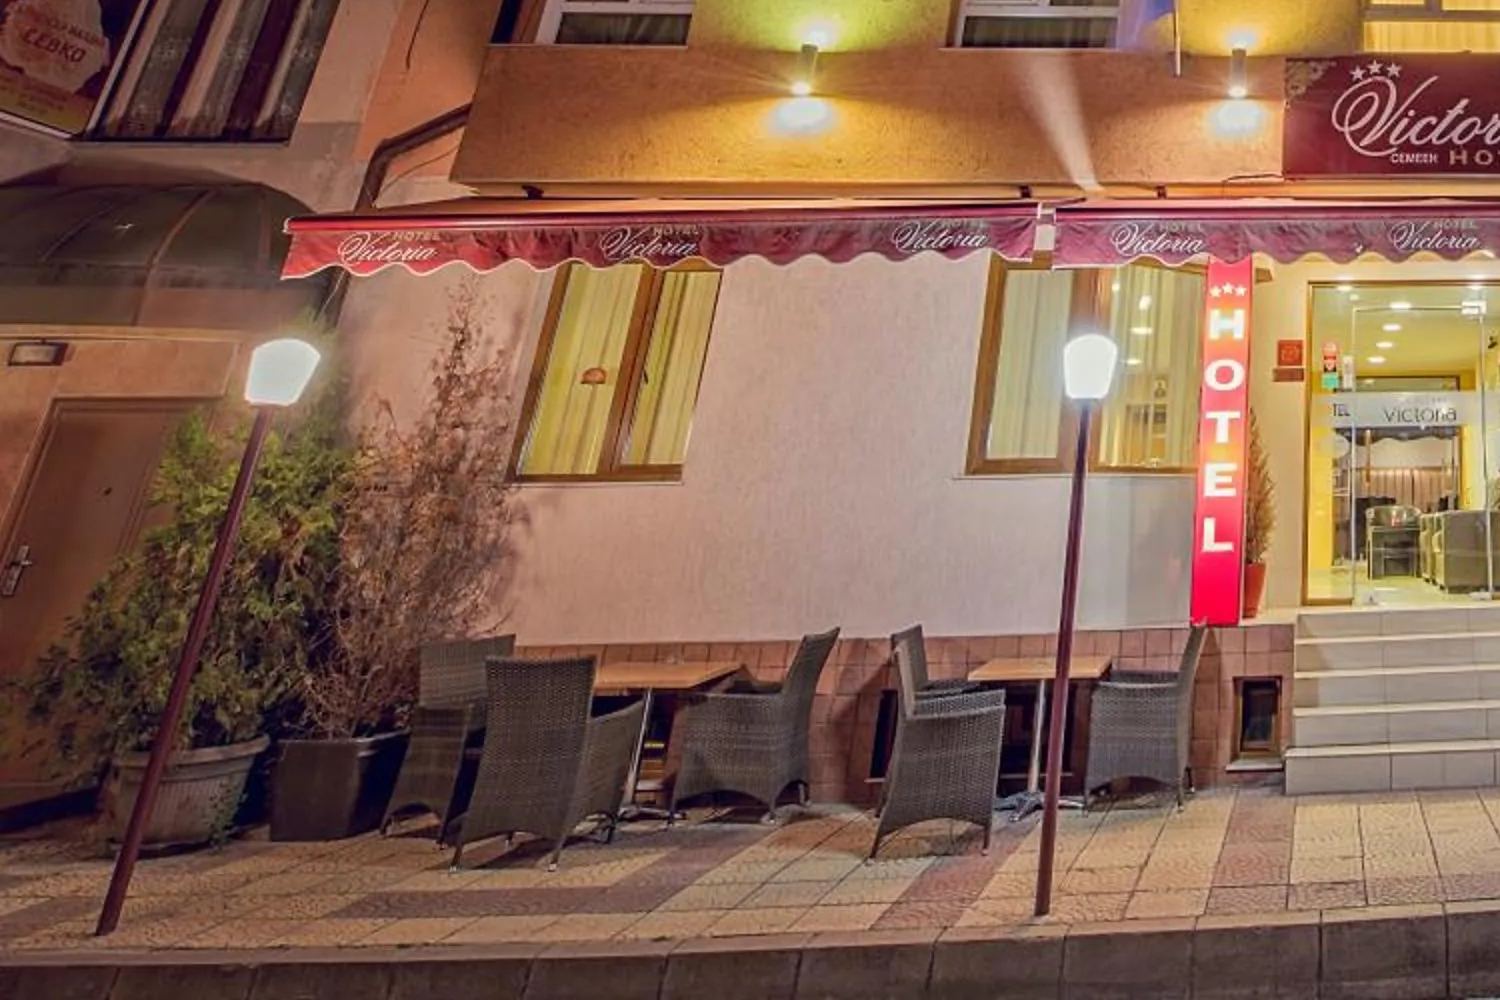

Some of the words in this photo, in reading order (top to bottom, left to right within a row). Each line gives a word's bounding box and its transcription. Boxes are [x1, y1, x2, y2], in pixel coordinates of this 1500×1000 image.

[337, 231, 437, 266] Victoria
[600, 226, 698, 261] Victoria
[891, 219, 988, 254] Victoria
[1110, 222, 1203, 257] Victoria
[1387, 220, 1481, 253] Victoria
[1203, 308, 1245, 553] HOTEL
